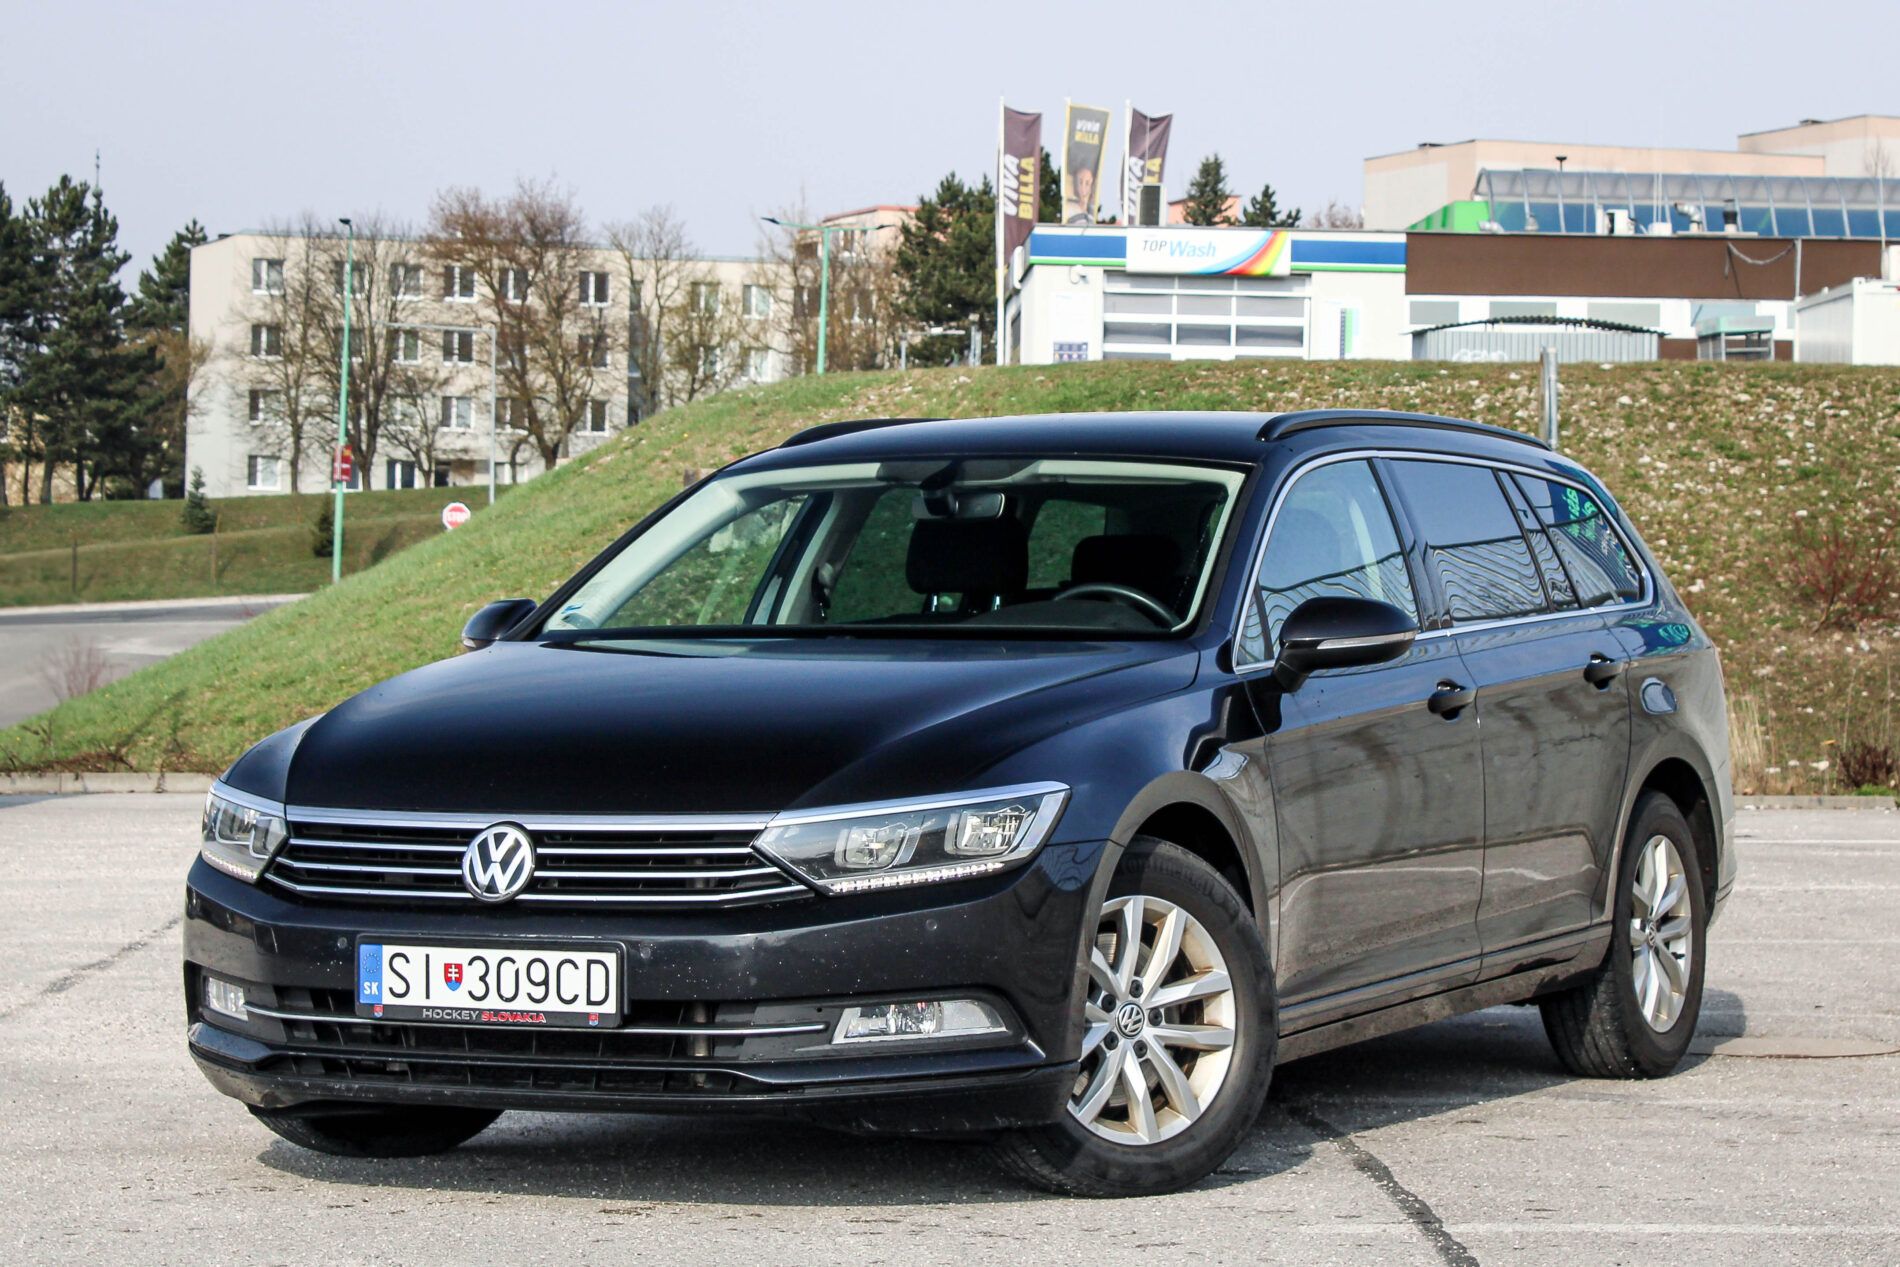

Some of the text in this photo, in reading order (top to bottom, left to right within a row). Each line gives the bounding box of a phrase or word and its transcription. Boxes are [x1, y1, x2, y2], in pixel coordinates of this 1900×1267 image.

[1003, 153, 1020, 217] VIVA
[1018, 156, 1035, 220] BILLA
[1143, 239, 1217, 257] TOP Wash
[363, 981, 379, 996] SK
[388, 952, 610, 1006] SI 309CD
[422, 1008, 547, 1024] HOCKEY SLOVAKIA
